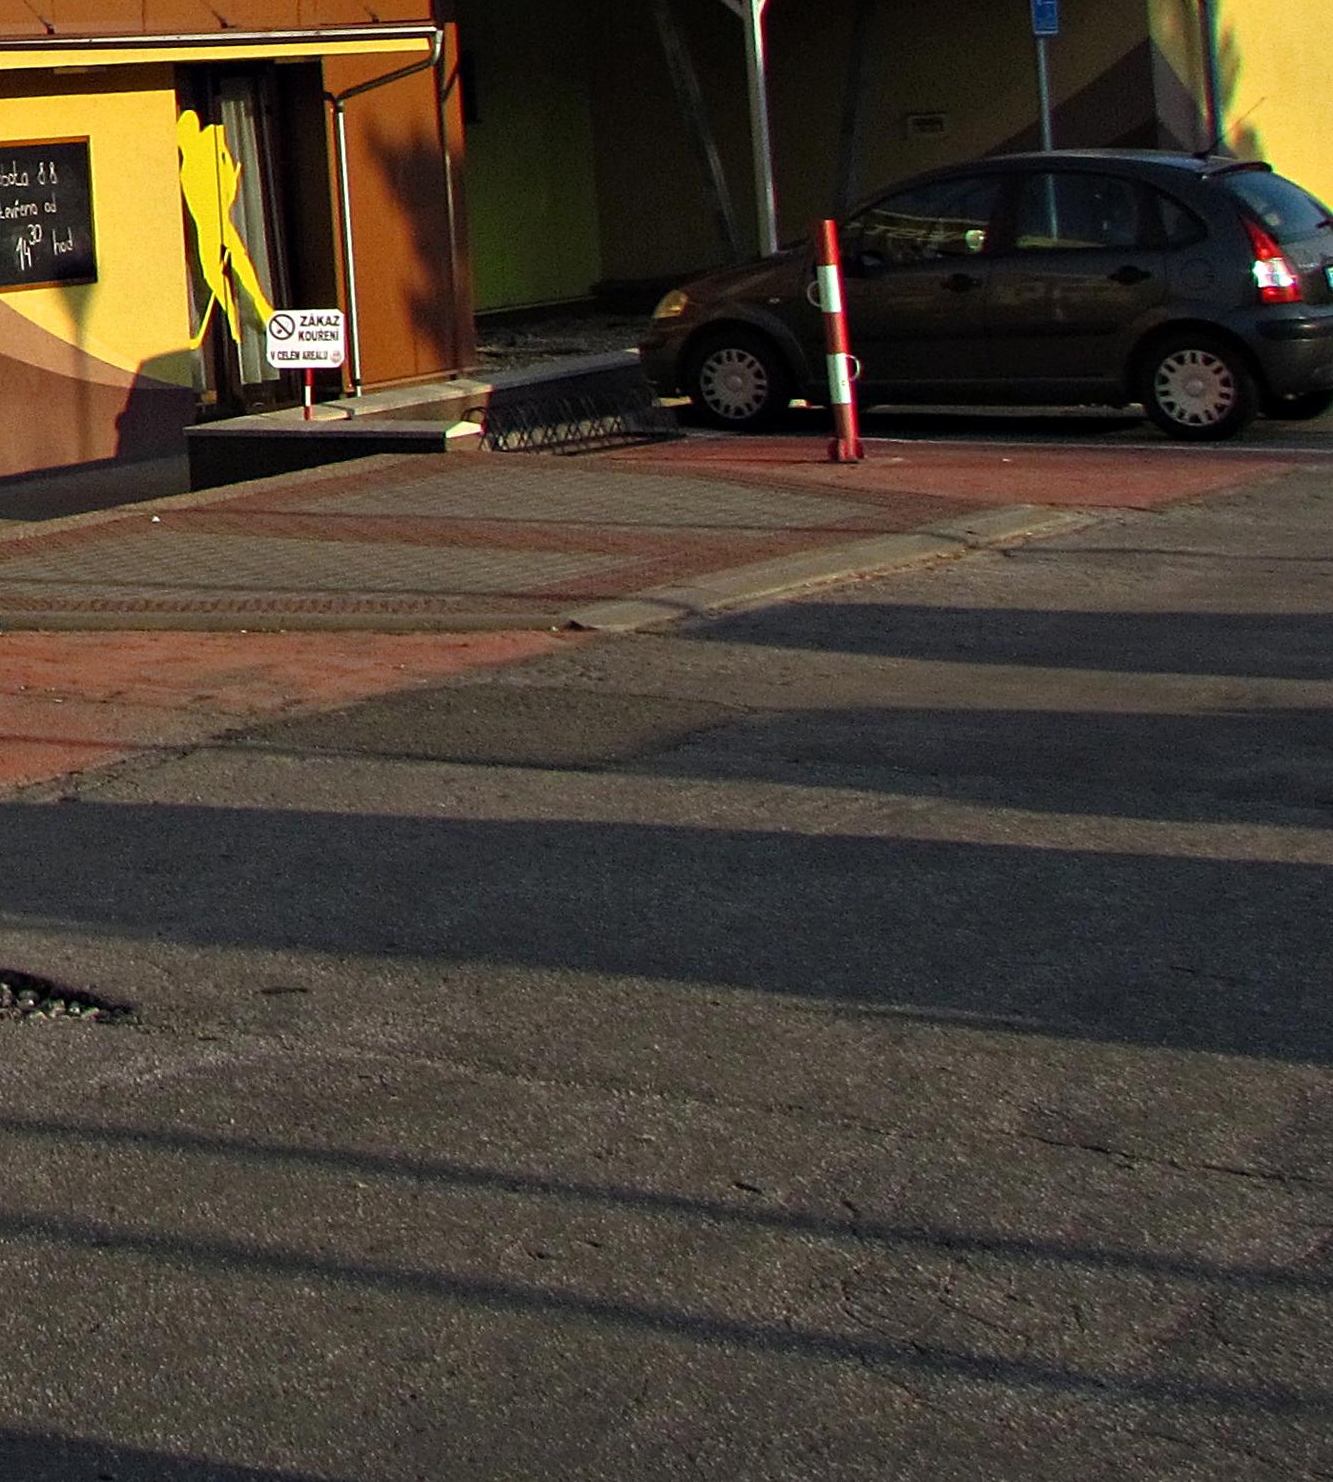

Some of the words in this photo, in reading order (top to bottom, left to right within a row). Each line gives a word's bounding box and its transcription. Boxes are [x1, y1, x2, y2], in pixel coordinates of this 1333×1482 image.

[44, 192, 57, 213] od
[52, 226, 73, 256] hod
[299, 313, 340, 327] ZÁKAZ
[298, 328, 339, 342] KOUŘENÍ
